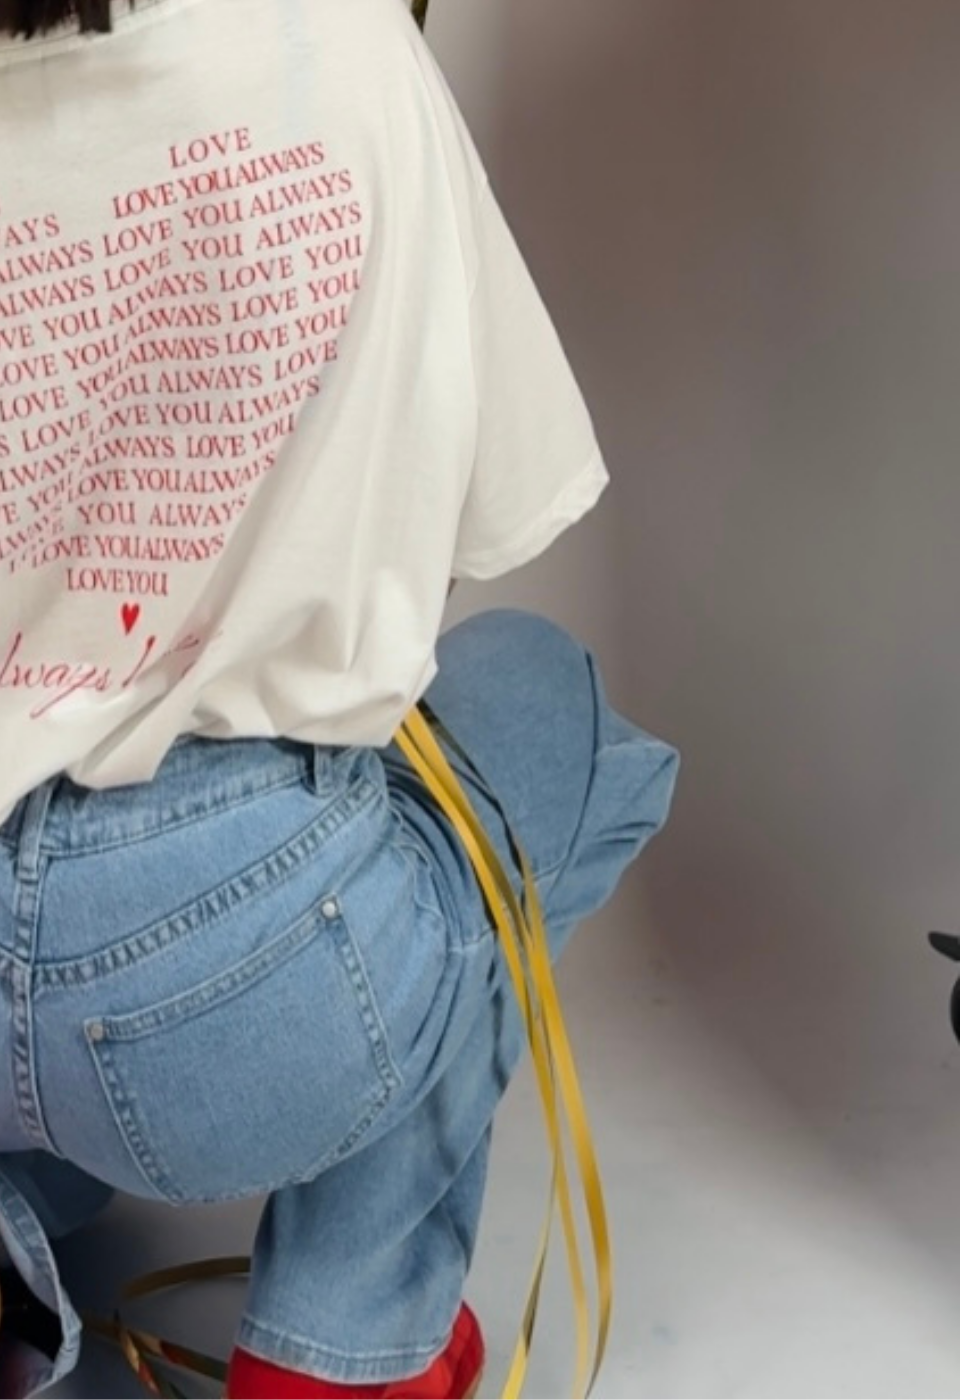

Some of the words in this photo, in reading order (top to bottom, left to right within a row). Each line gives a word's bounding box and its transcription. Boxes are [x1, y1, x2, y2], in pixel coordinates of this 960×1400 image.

[169, 127, 251, 169] LOVE
[102, 218, 174, 258] LOVE
[183, 200, 244, 230] YOU
[249, 169, 353, 218] ALWAYS
[112, 181, 178, 219] LOVE
[103, 248, 172, 292] LOVE
[182, 234, 244, 262] YOU
[256, 201, 362, 250] ALWAYS
[42, 307, 102, 341] YOU
[108, 271, 208, 325] ALWAYS
[219, 255, 295, 293] LOVE
[305, 235, 362, 270] YOU
[62, 333, 120, 371] YOU
[124, 302, 222, 344] ALWAYS
[231, 287, 299, 323] LOVE
[307, 269, 361, 304] YOU
[76, 359, 124, 400] YOU
[124, 337, 220, 369] ALWAYS
[225, 324, 289, 355] LOVE
[295, 305, 348, 341] YOU
[21, 410, 91, 453] LOVE
[99, 373, 150, 410] YOU
[157, 364, 263, 394] ALWAYS
[274, 339, 338, 382] LOVE
[88, 404, 150, 446] LOVE
[156, 402, 212, 426] YOU
[218, 375, 321, 425] ALWAYS
[80, 435, 177, 473] ALWAYS
[186, 435, 247, 459] LOVE
[252, 413, 296, 450] YOU
[67, 468, 129, 504] LOVE
[131, 468, 181, 493] YOU
[77, 501, 136, 525] YOU
[32, 535, 91, 568] LOVE
[95, 535, 139, 560] YOU
[139, 533, 225, 562] ALWAYS
